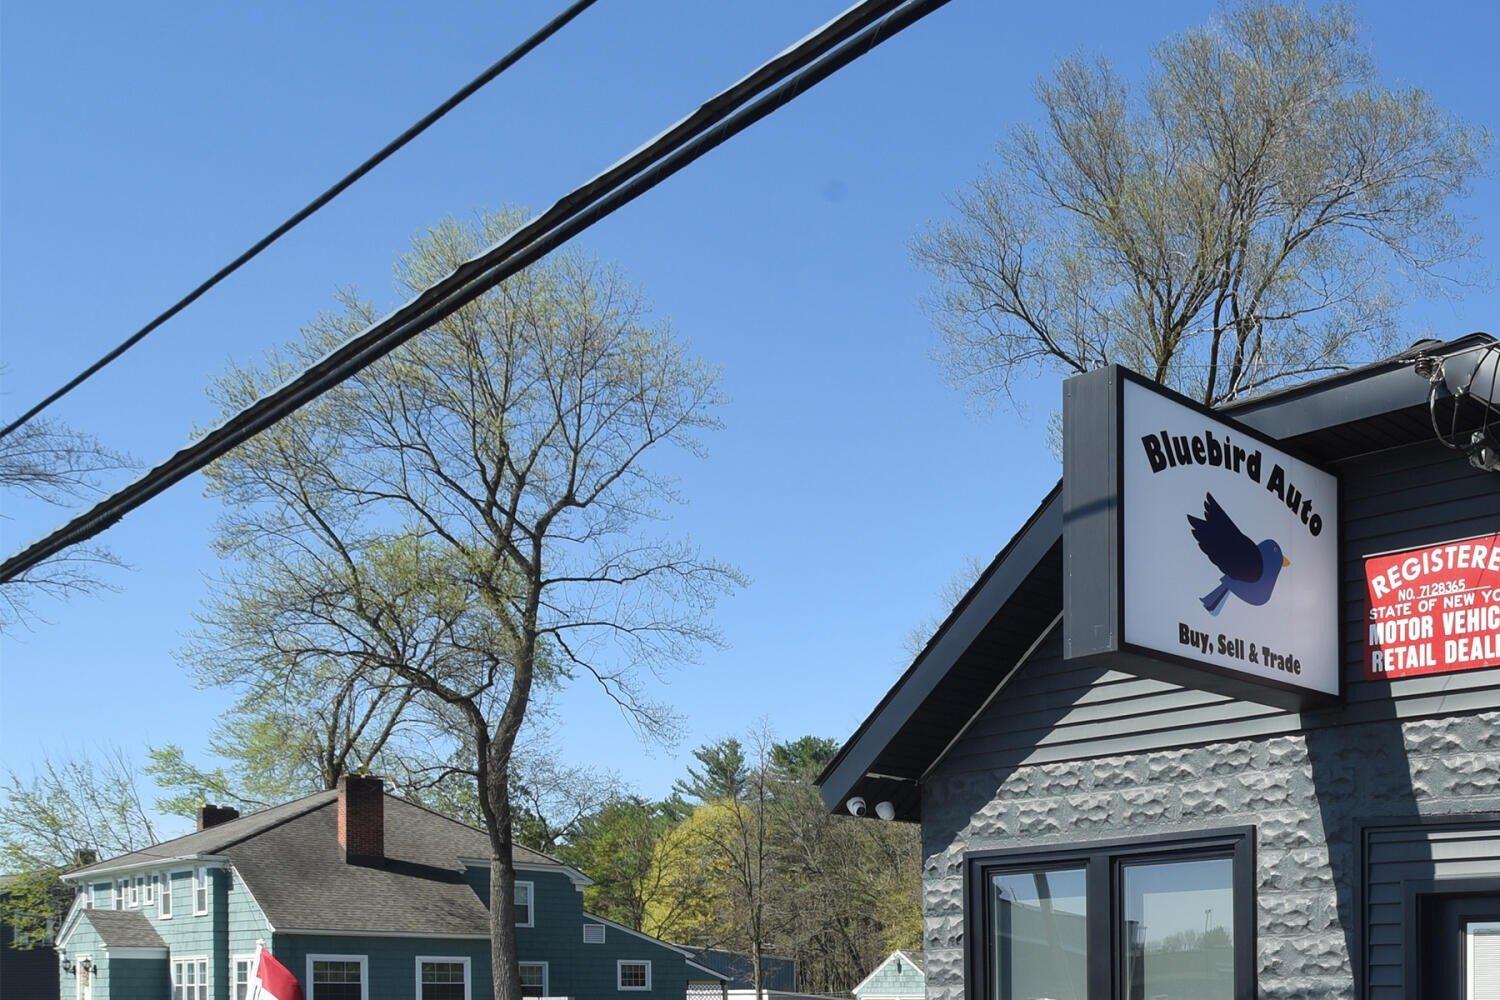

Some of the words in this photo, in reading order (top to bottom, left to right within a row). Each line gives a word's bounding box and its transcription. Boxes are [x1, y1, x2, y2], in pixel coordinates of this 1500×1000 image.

[1141, 430, 1263, 484] Bluebird
[1266, 463, 1323, 537] Auto
[1398, 587, 1416, 601] NO.
[1419, 579, 1466, 599] 7128365
[1369, 602, 1412, 620] STATE
[1418, 598, 1437, 613] OF
[1443, 593, 1475, 610] NEW
[1369, 615, 1434, 646] MOTOR
[1178, 622, 1214, 655] Buy,
[1217, 634, 1245, 660] Sell
[1248, 642, 1259, 664] &
[1262, 646, 1301, 675] Trade
[1371, 643, 1437, 673] RETAIL
